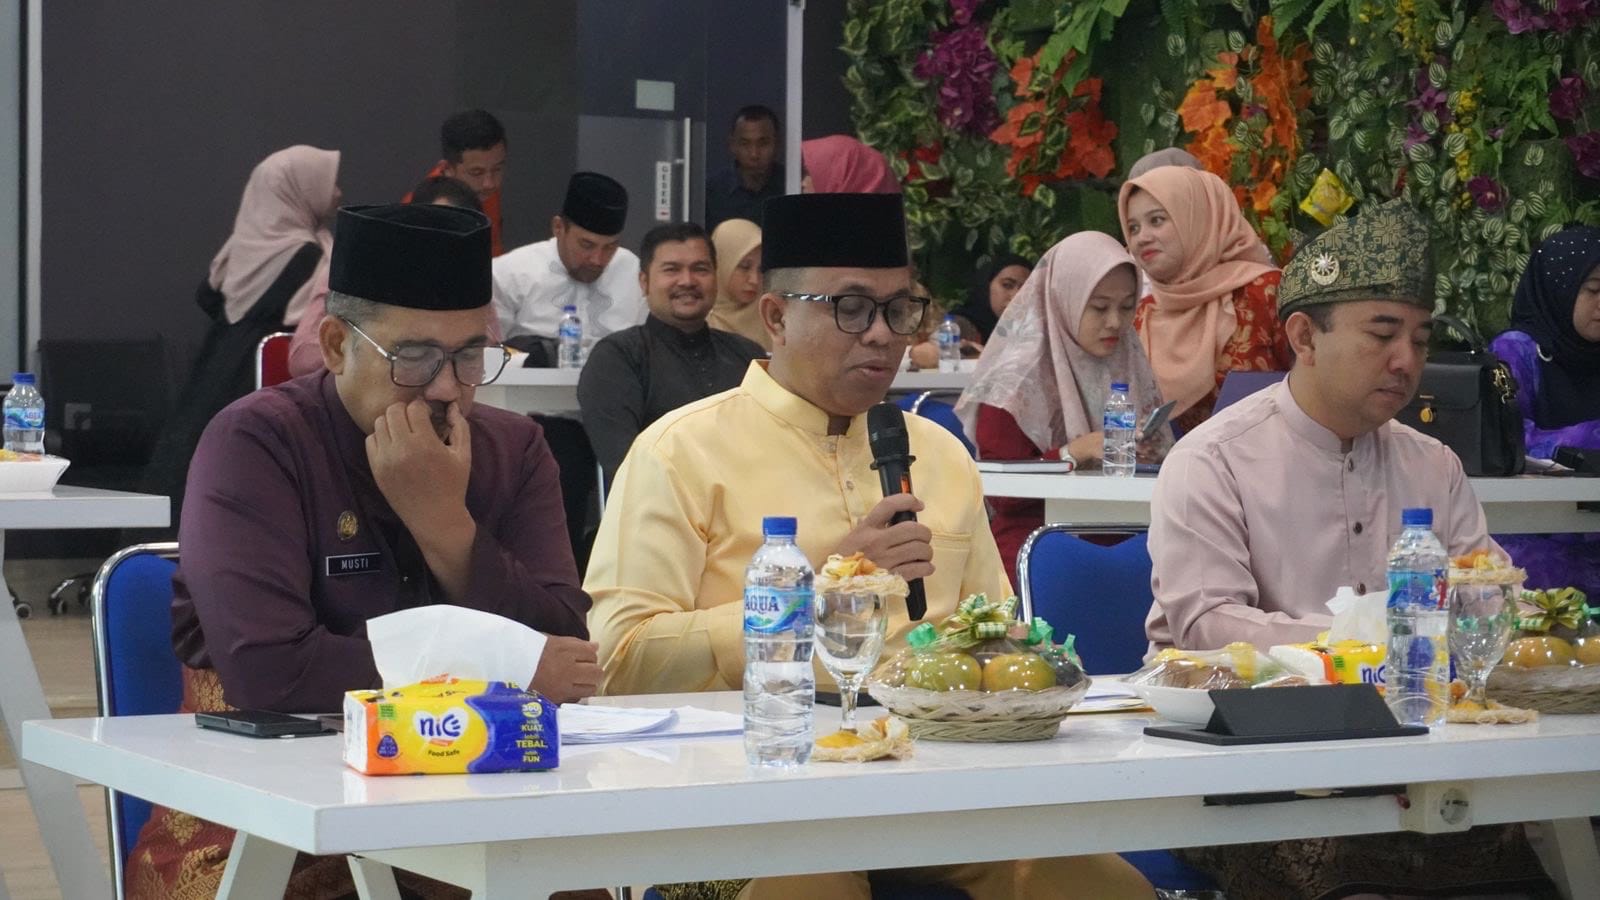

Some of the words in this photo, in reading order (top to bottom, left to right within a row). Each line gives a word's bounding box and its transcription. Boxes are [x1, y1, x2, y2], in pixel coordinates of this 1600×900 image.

[341, 557, 369, 570] MUSTI
[744, 595, 780, 614] AQUA
[428, 749, 445, 757] Food
[446, 749, 460, 757] Safe
